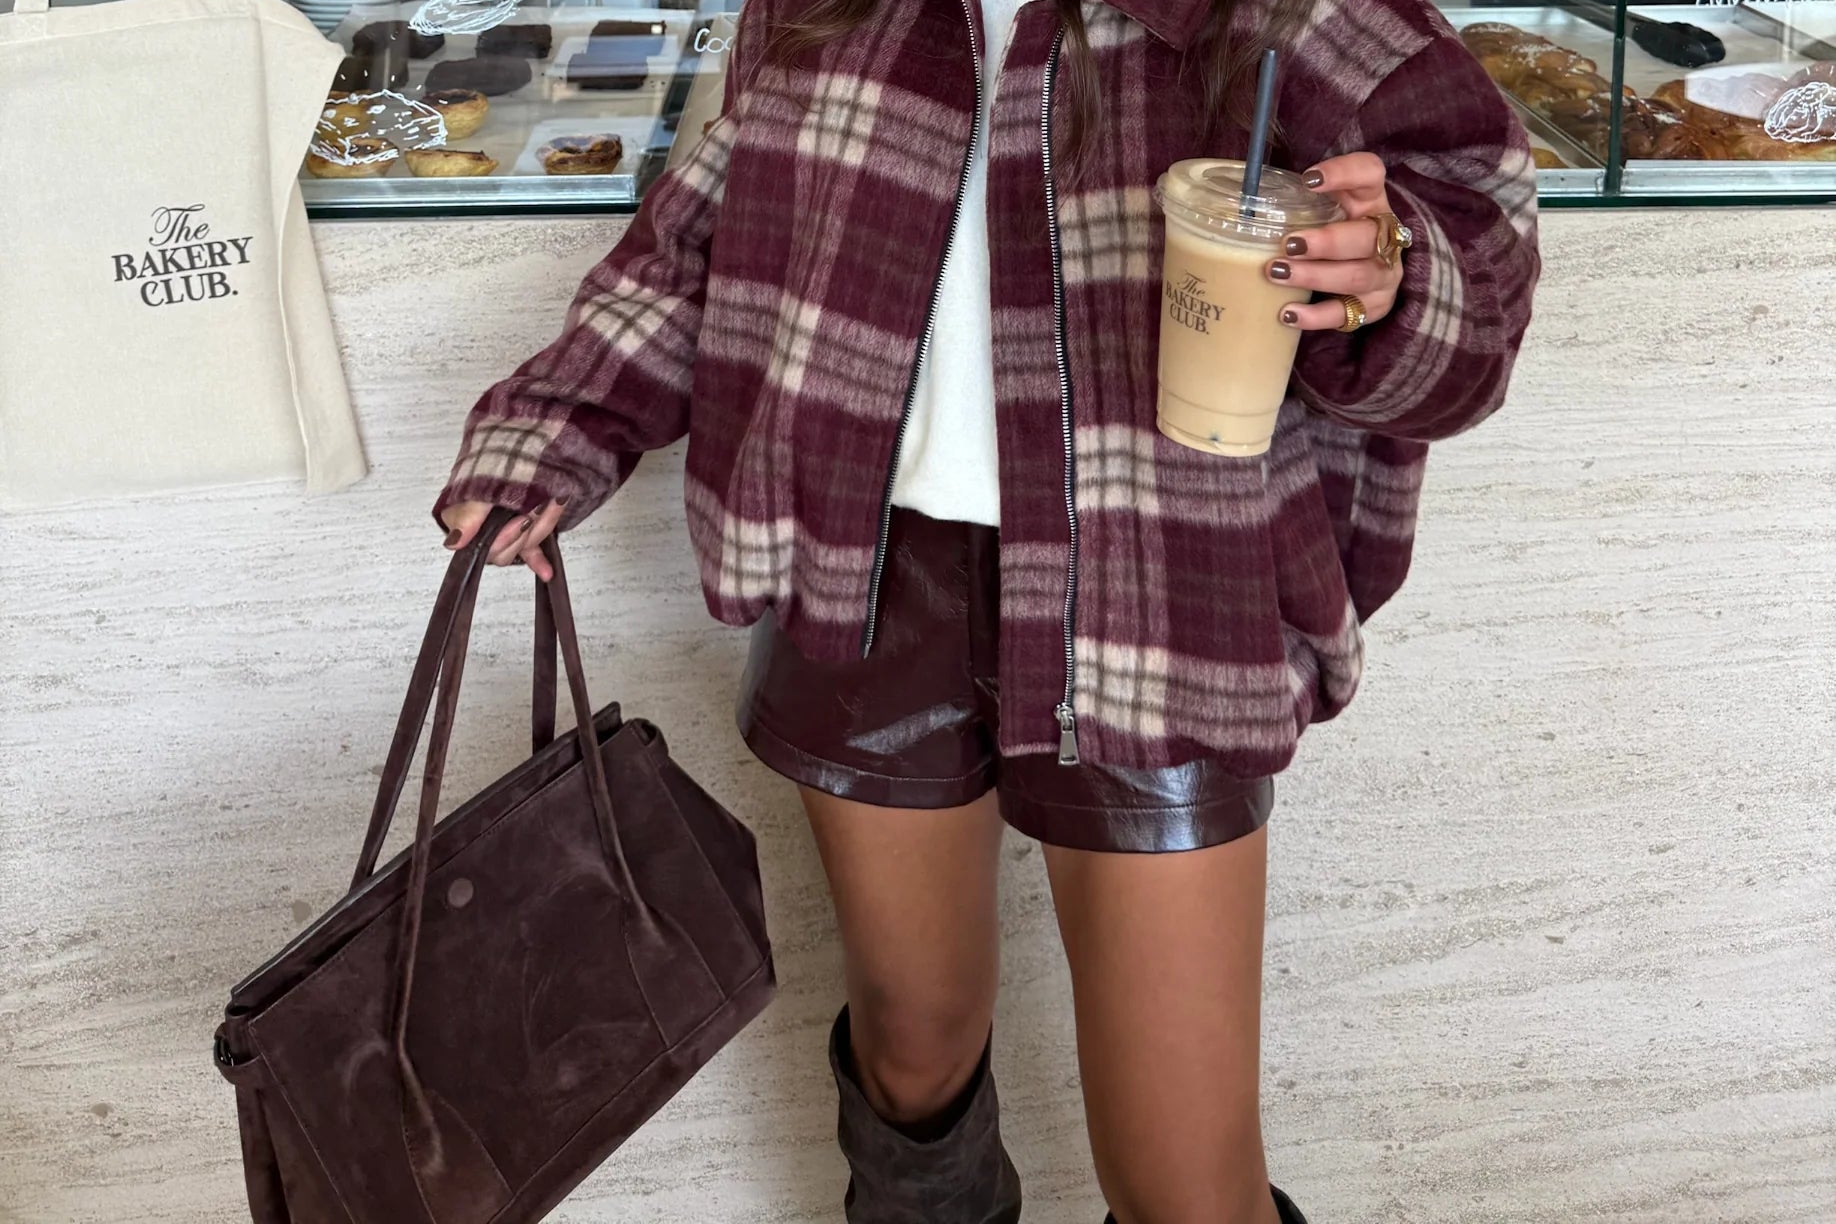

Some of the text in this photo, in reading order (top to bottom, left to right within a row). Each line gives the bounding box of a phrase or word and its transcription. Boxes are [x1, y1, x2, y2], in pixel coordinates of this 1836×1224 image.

[148, 202, 211, 247] The
[111, 236, 254, 282] BAKERY
[140, 271, 240, 307] CLUB.
[1165, 279, 1227, 322] BAKERY
[1176, 269, 1208, 297] The
[1169, 302, 1211, 336] CLUB.
